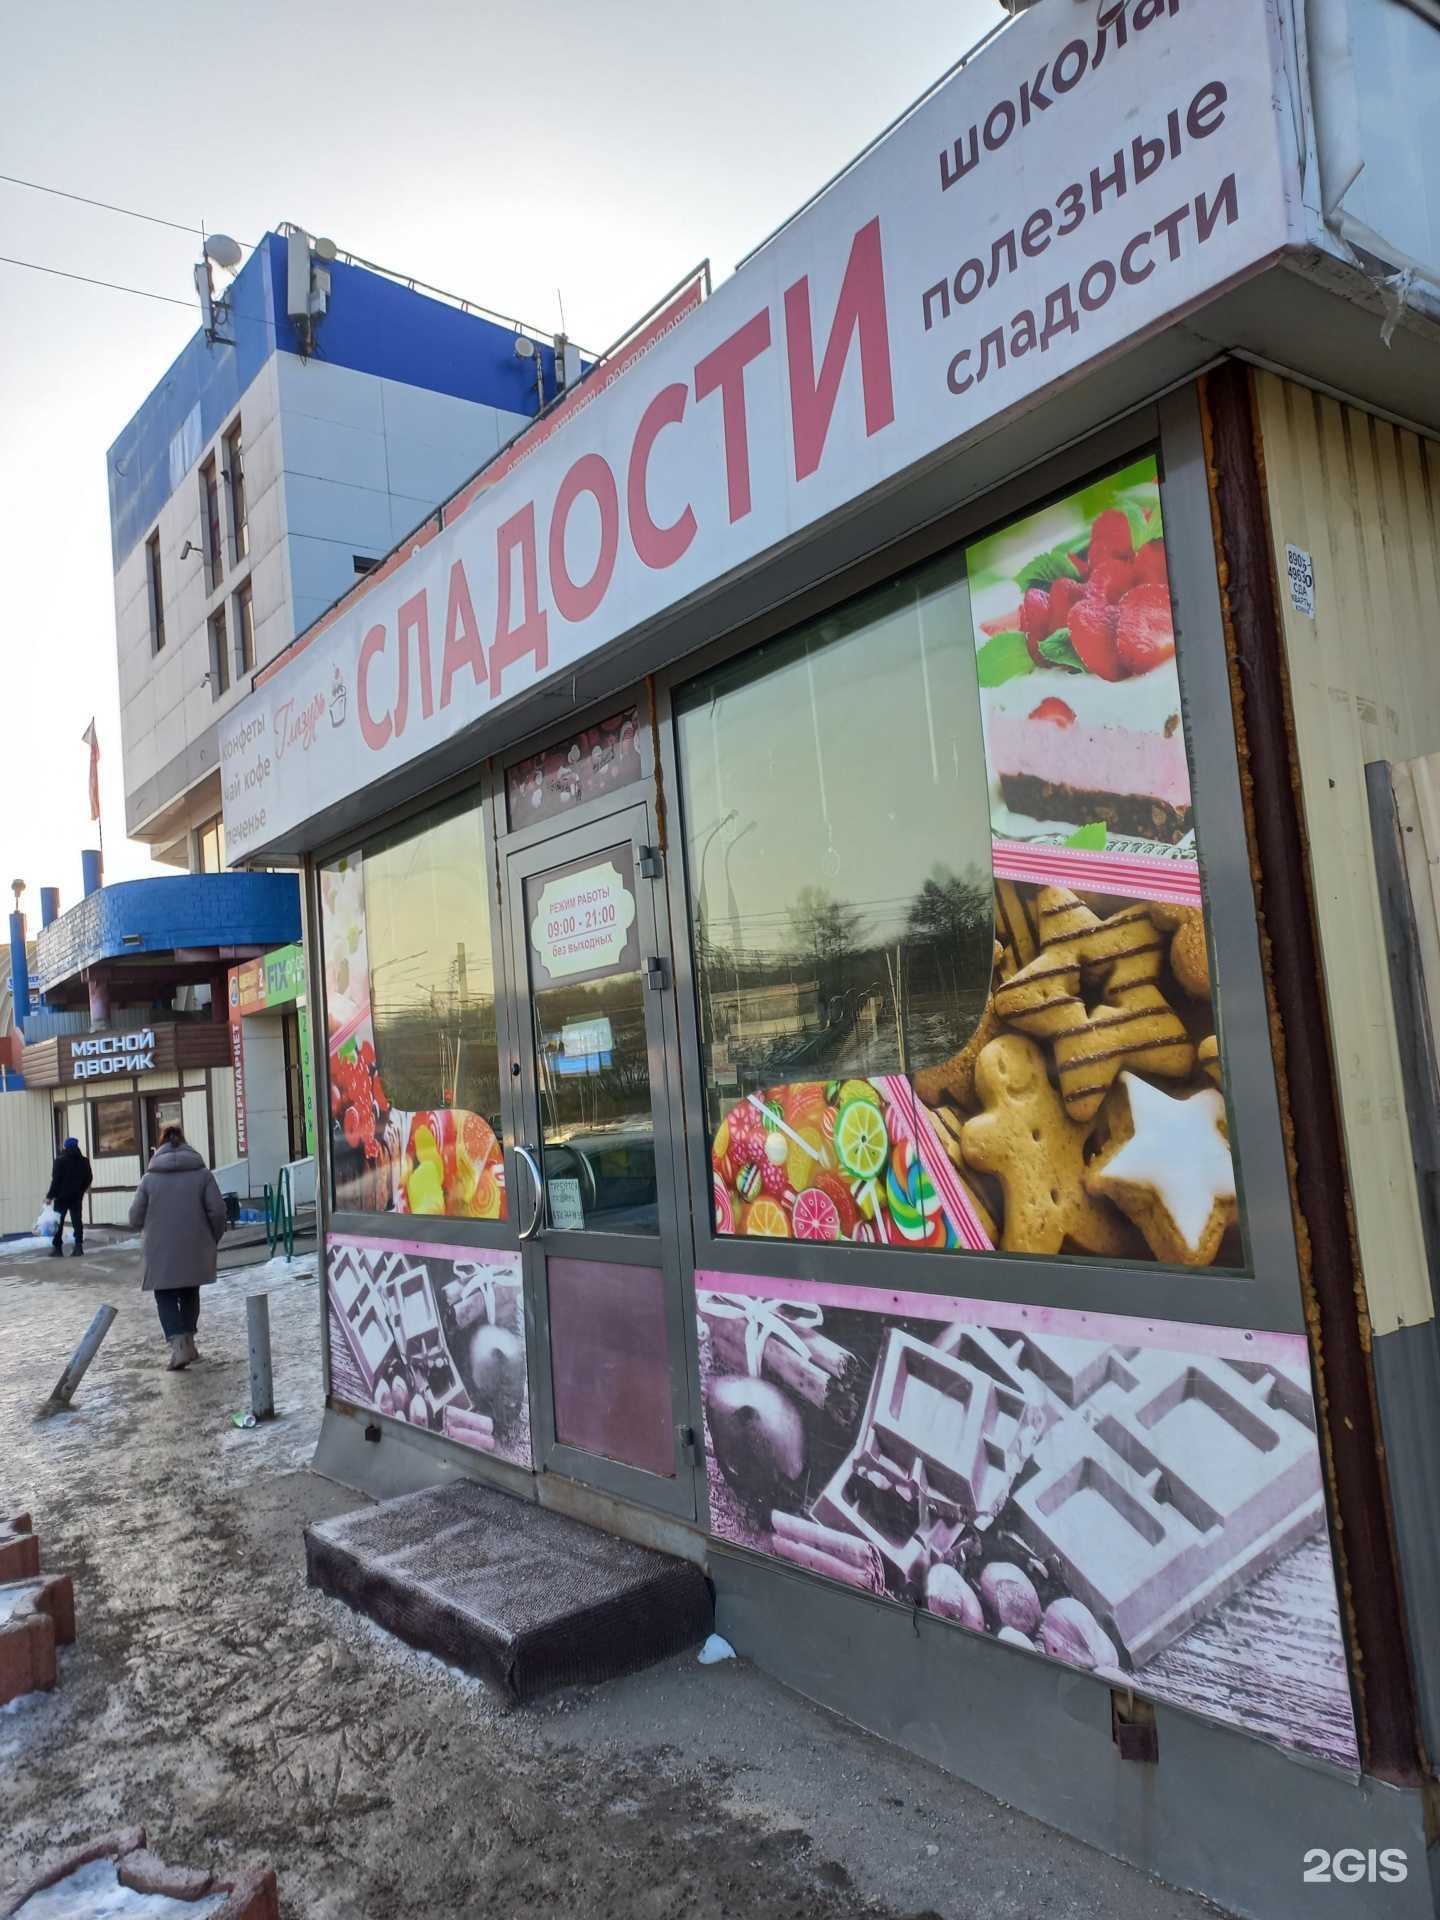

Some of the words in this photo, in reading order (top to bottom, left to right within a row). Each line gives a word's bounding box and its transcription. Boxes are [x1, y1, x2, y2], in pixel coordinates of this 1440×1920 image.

[939, 0, 1179, 192] шокола
[922, 80, 1228, 331] полезные
[946, 172, 1240, 395] сладости
[356, 214, 895, 751] СЛАДОСТИ
[244, 753, 271, 790] кофе
[225, 808, 266, 848] печенье
[549, 896, 577, 914] РЕЖИМ
[577, 886, 610, 905] РАБОТЫ
[547, 915, 576, 938] 09:00
[585, 903, 615, 929] 21:00
[552, 944, 567, 957] без
[568, 933, 613, 953] выходных
[267, 959, 288, 994] FIX
[71, 1028, 156, 1058] МЯСНОЙ
[73, 1052, 156, 1080] ДВОРИК
[232, 1023, 246, 1152] ГИПЕРМАРКЕТ
